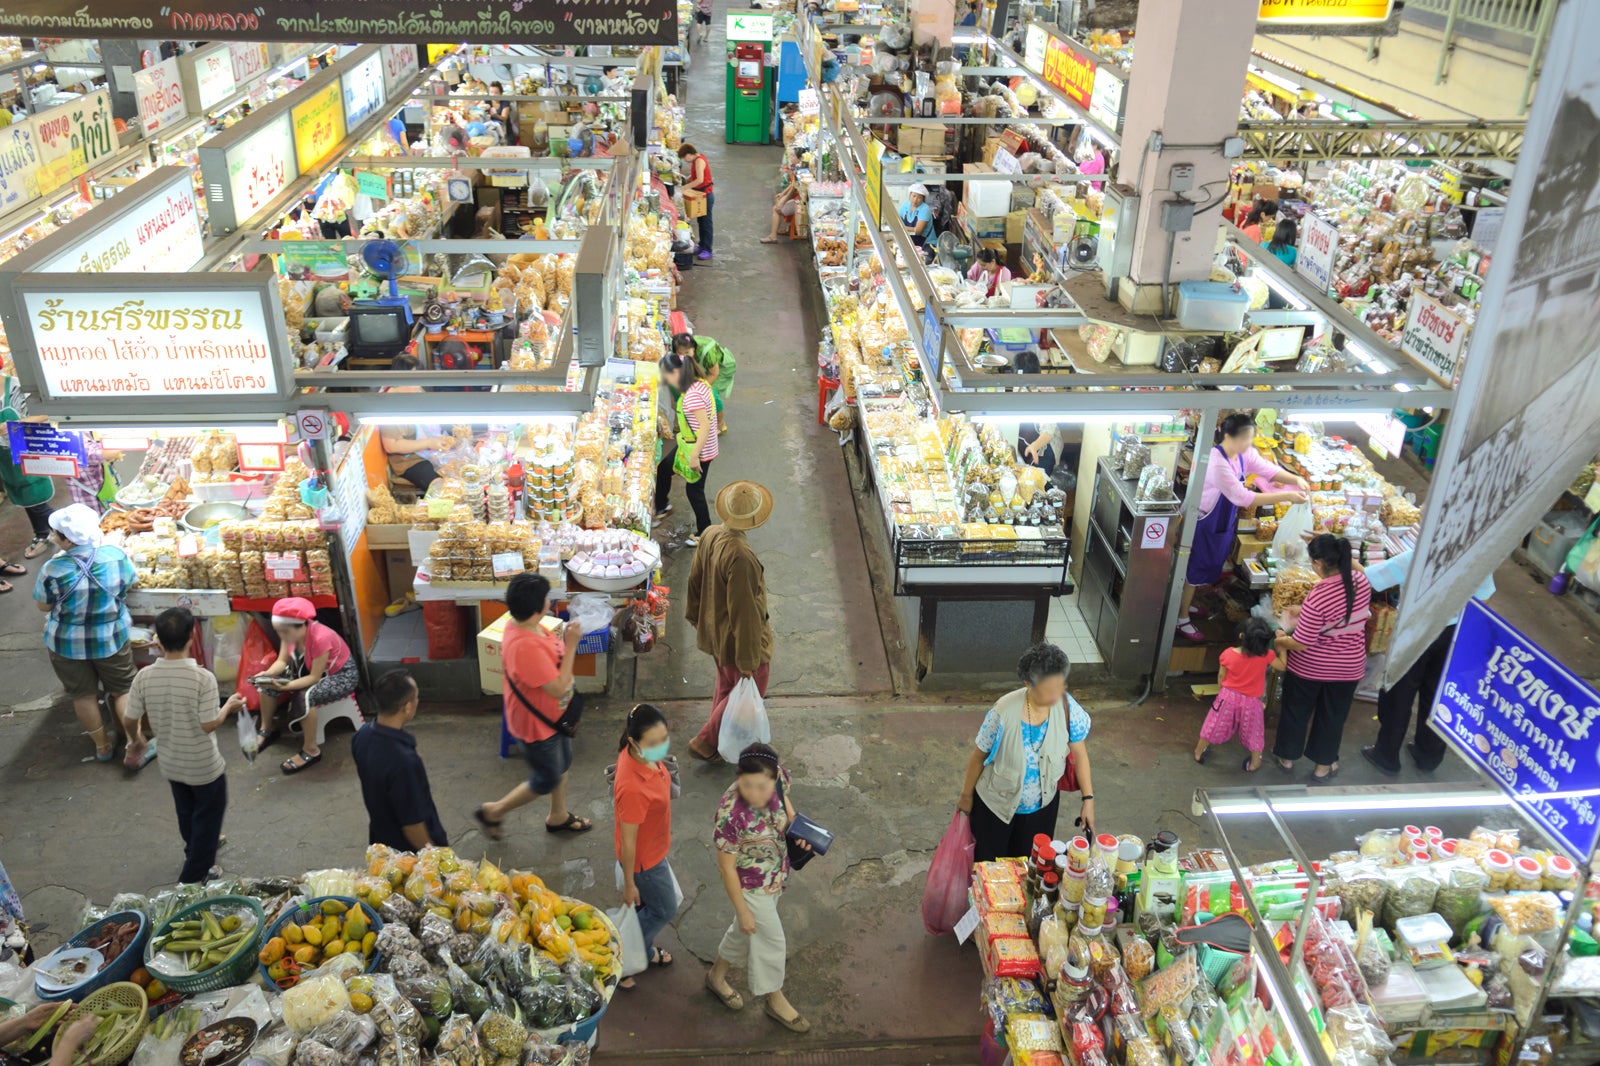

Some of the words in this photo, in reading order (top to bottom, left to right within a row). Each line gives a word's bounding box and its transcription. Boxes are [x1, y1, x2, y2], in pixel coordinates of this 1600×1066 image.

[38, 299, 243, 331] ร้านศรีพรรณ
[40, 345, 107, 366] หมูทอด
[107, 336, 159, 361] ไส้อั่ว
[166, 335, 267, 364] น้ำพริกหนุ่ม
[60, 373, 150, 392] แหนมหม้อ
[163, 365, 265, 391] แหนมซี่โครง
[1478, 670, 1576, 774] น้ำพริกหนุ่ม
[1488, 751, 1518, 787] (053)
